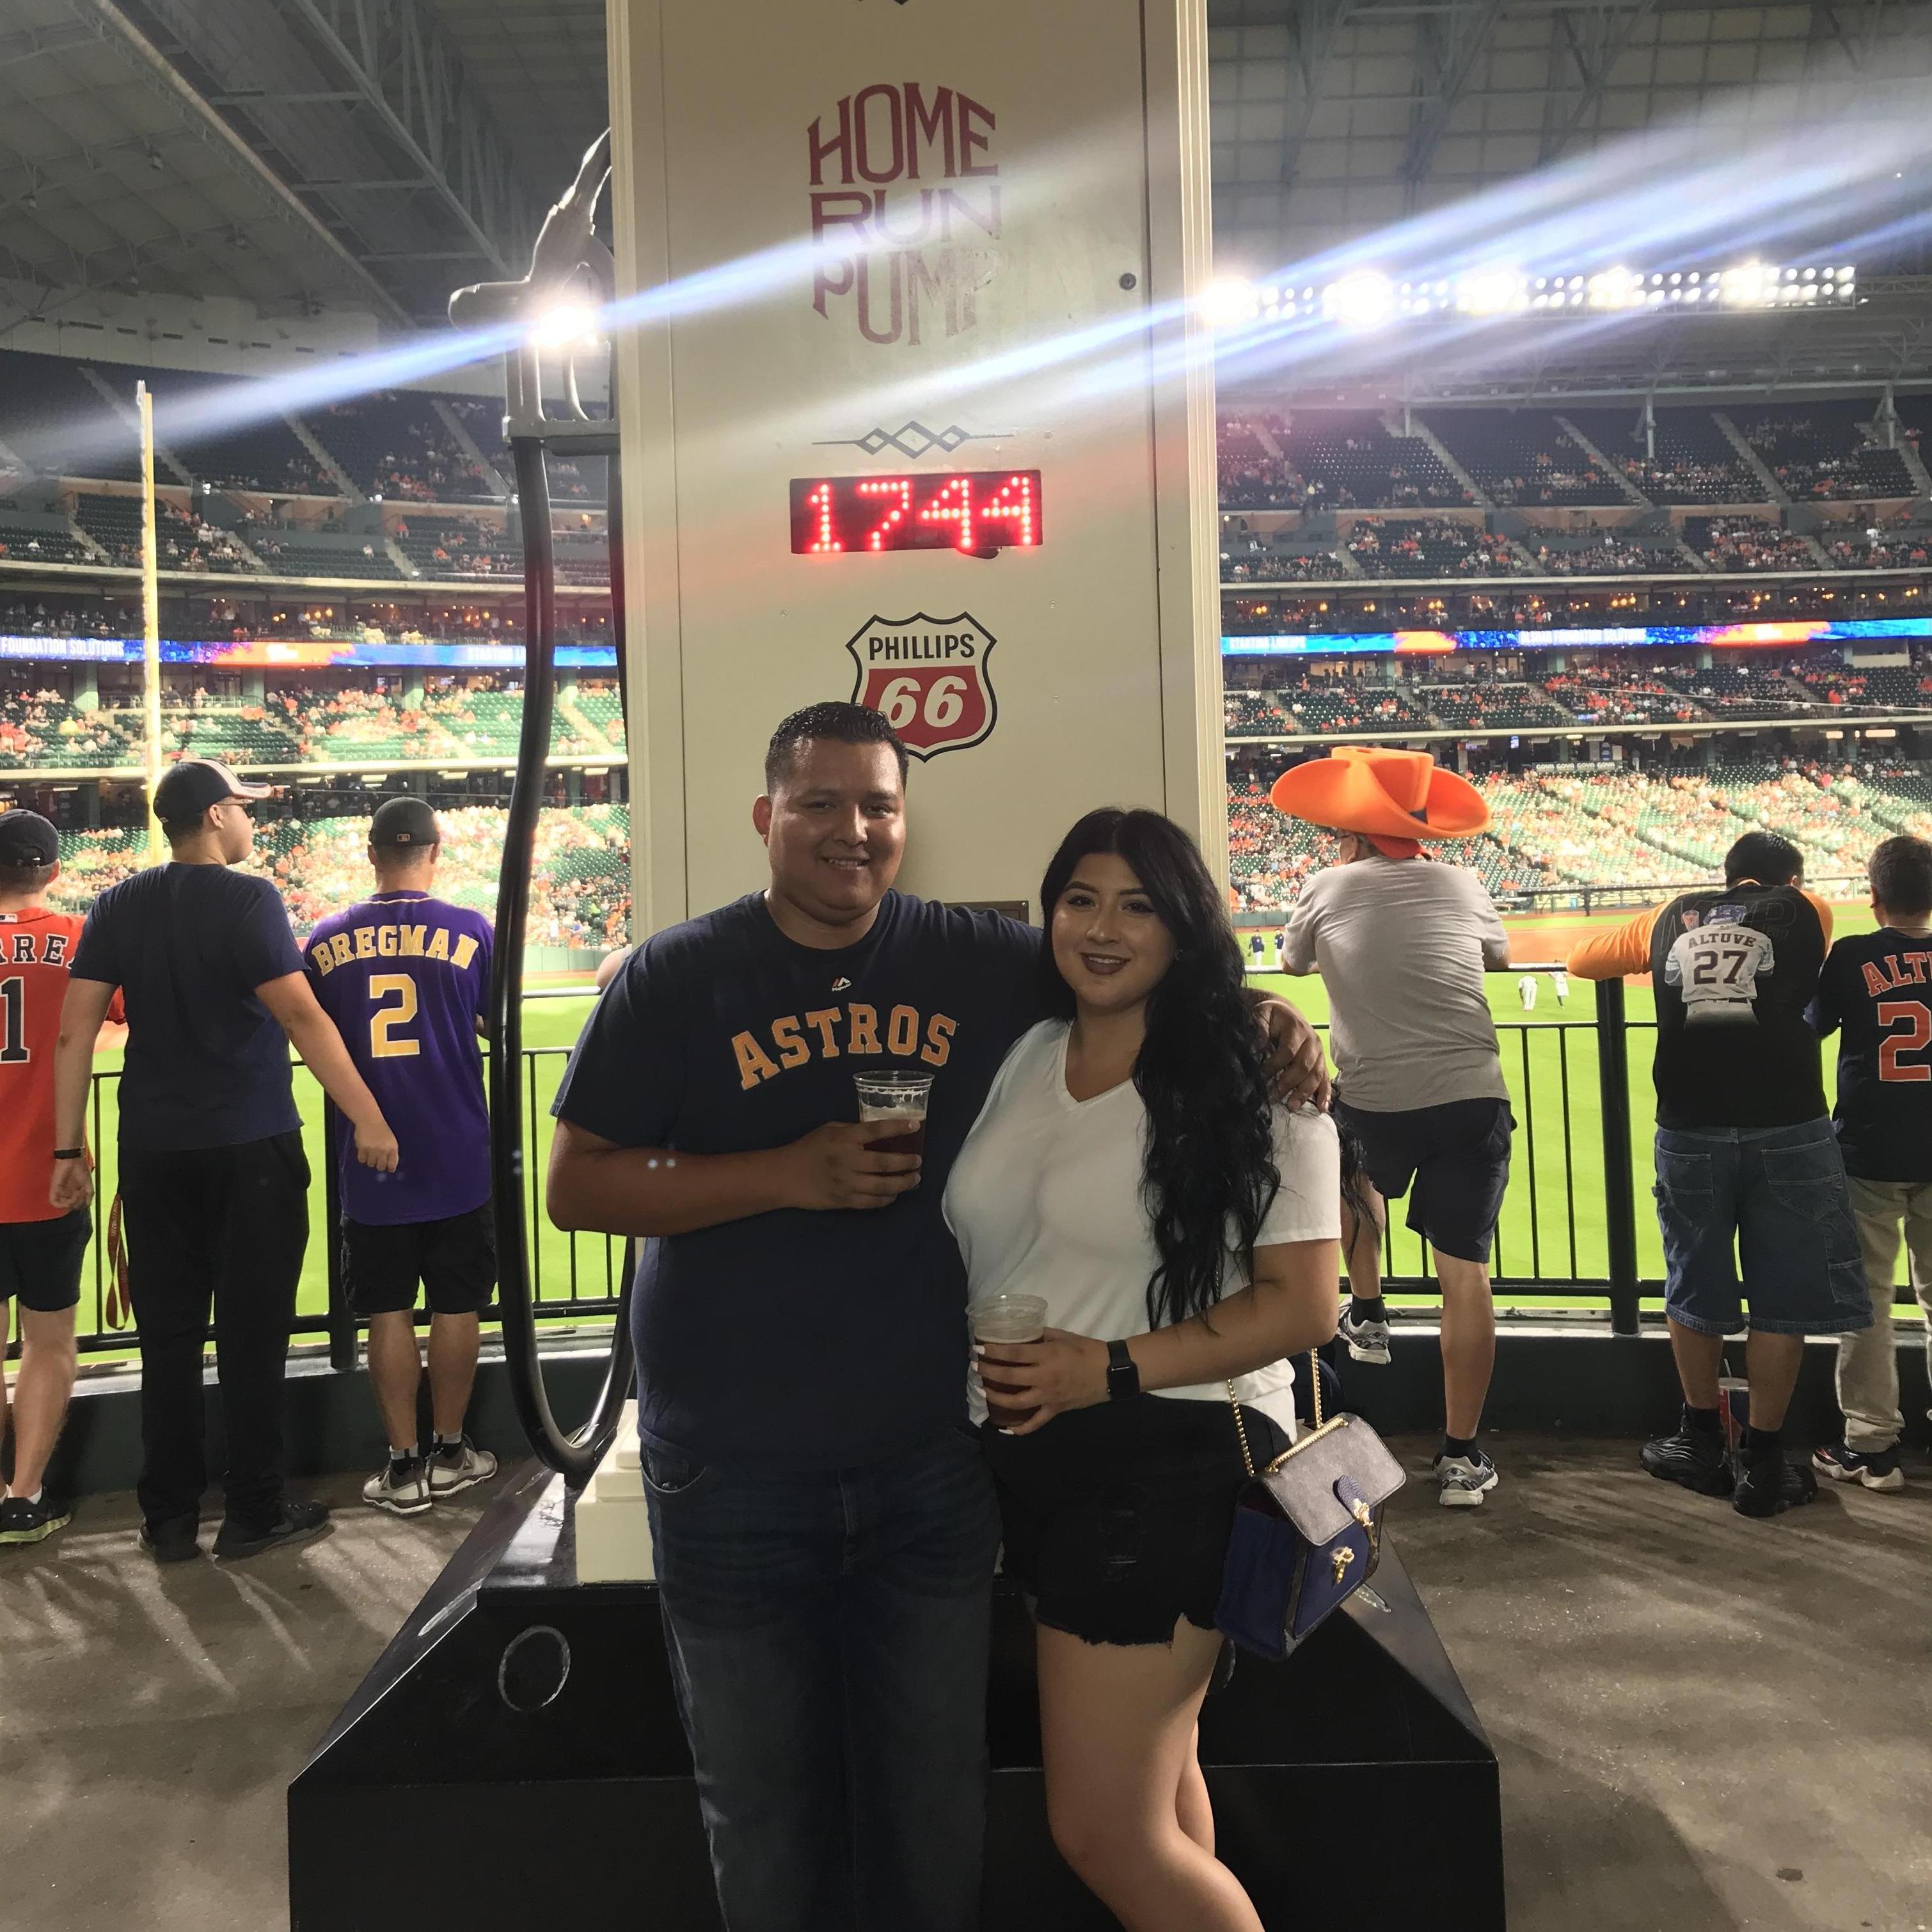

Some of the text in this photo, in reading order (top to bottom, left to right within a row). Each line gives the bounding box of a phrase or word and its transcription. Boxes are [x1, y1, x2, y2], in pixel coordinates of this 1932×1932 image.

[807, 83, 998, 185] HOME
[809, 186, 1001, 246] RUN
[807, 475, 1031, 549] 1744
[1, 637, 125, 657] FOUNDATION SOLUTIONS
[869, 633, 975, 661] PHILLIPS
[877, 676, 967, 729] 66
[0, 933, 75, 969] RE
[312, 925, 480, 976] BREGMAN
[1689, 933, 1757, 949] ALTUVE
[1694, 950, 1748, 985] 27
[1861, 951, 1932, 997] ALT
[0, 976, 31, 1063] 1
[370, 973, 420, 1057] 2
[1878, 1001, 1932, 1081] 2
[732, 1002, 957, 1090] ASTROS
